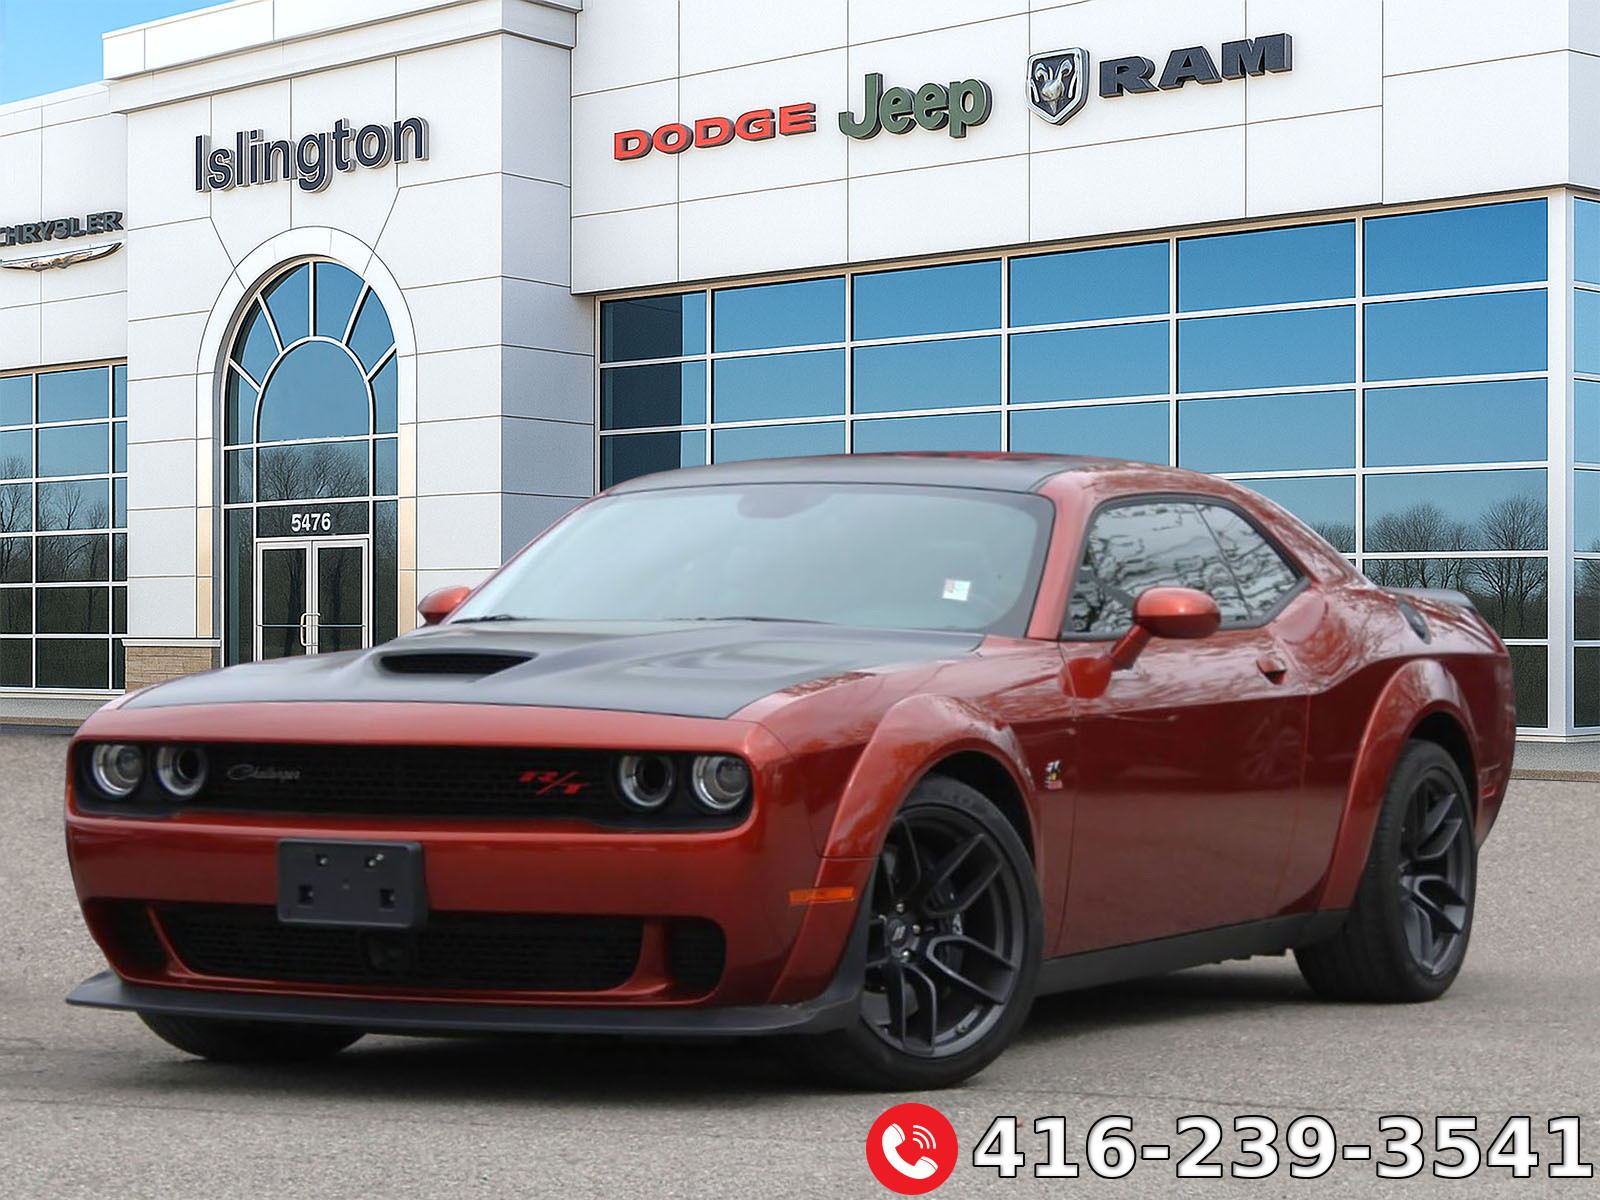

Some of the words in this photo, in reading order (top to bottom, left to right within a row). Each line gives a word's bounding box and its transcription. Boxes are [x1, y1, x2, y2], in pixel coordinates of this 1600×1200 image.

[614, 102, 816, 161] DODGE
[838, 72, 992, 138] Jeep
[1099, 33, 1293, 98] RAM
[195, 115, 429, 193] Islington
[291, 512, 331, 532] 5476
